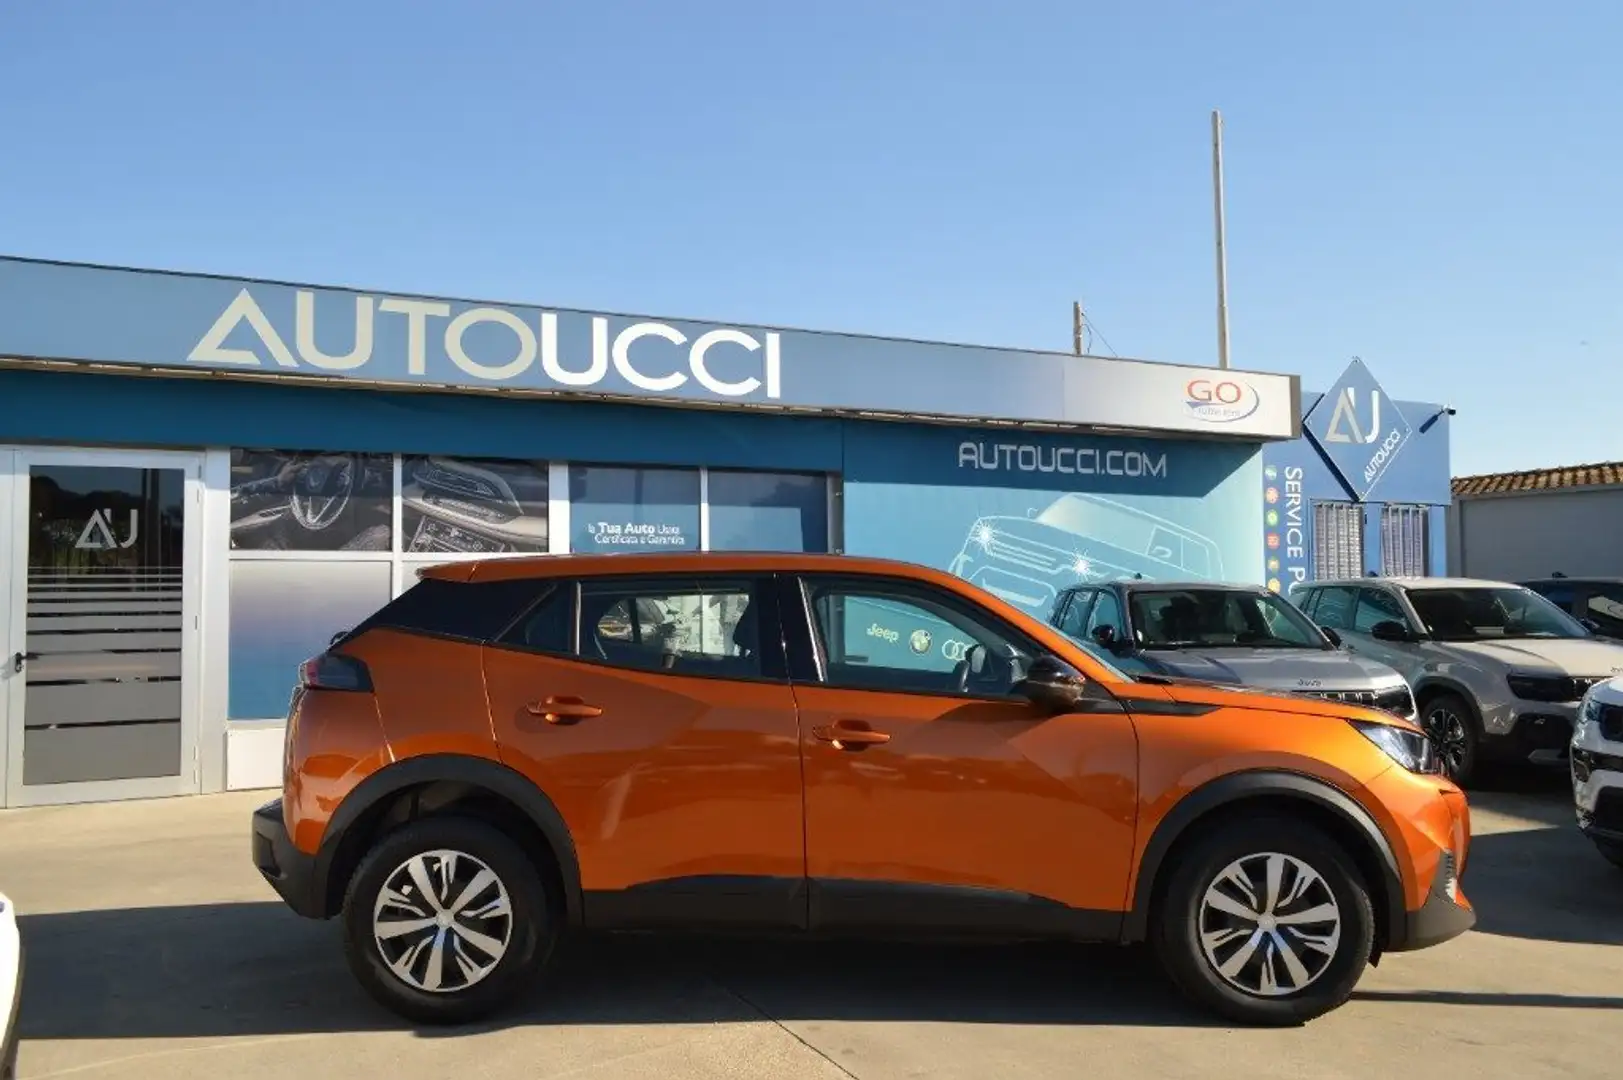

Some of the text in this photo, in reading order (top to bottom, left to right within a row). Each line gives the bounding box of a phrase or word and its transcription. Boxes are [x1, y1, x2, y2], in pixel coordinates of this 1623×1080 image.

[187, 288, 781, 399] AUTOUCCI
[1187, 380, 1242, 404] GO
[958, 442, 1167, 478] AUTOUCCI.COM
[1364, 427, 1401, 483] AUTOUCCI
[598, 522, 621, 534] Tua
[624, 523, 656, 534] Auto
[1285, 466, 1303, 558] SERVICE
[866, 623, 900, 643] Jeep
